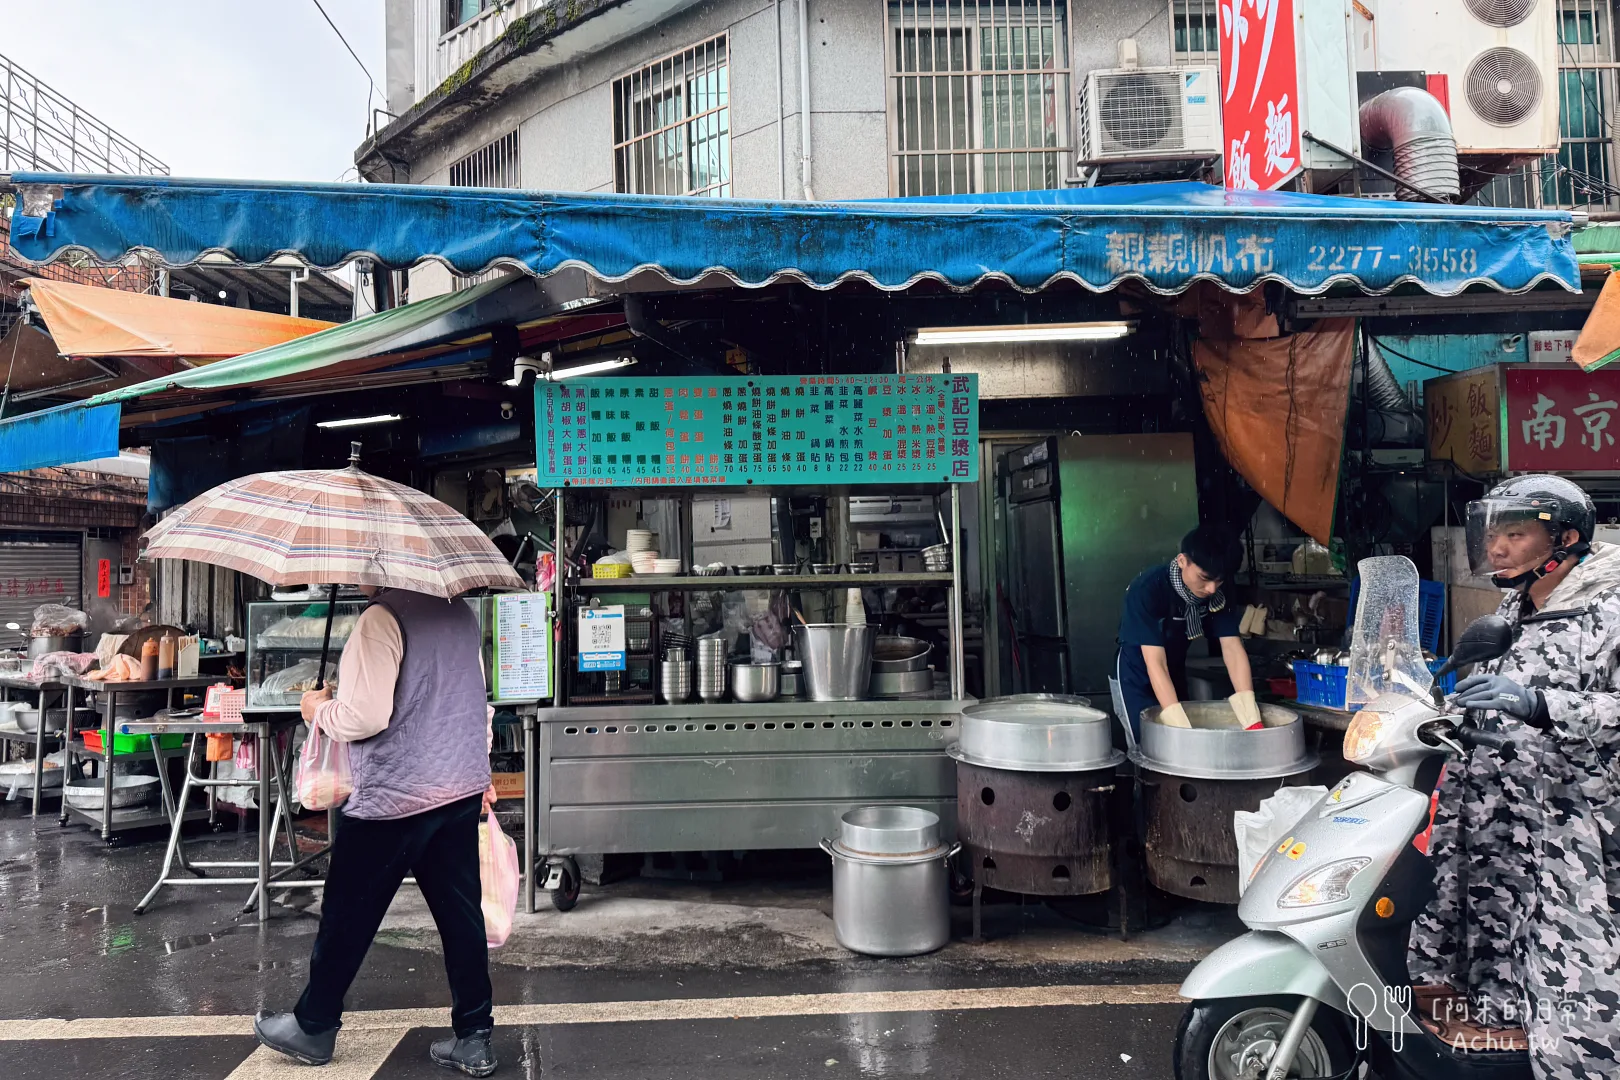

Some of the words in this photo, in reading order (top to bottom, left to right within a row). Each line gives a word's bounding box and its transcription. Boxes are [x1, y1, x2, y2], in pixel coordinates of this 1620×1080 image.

[1264, 93, 1296, 177] 麵
[1229, 130, 1259, 191] 飯
[1308, 244, 1479, 274] 2277-3558
[1430, 396, 1459, 451] 炒
[1467, 379, 1494, 462] 飯麵
[1522, 392, 1618, 452] 南京
[951, 376, 971, 477] 武記豆漿店
[652, 466, 660, 474] 45
[681, 466, 690, 474] 40
[696, 466, 704, 474] 40
[797, 464, 807, 472] 40
[814, 464, 818, 472] 8
[827, 464, 831, 472] 8
[898, 463, 907, 471] 25
